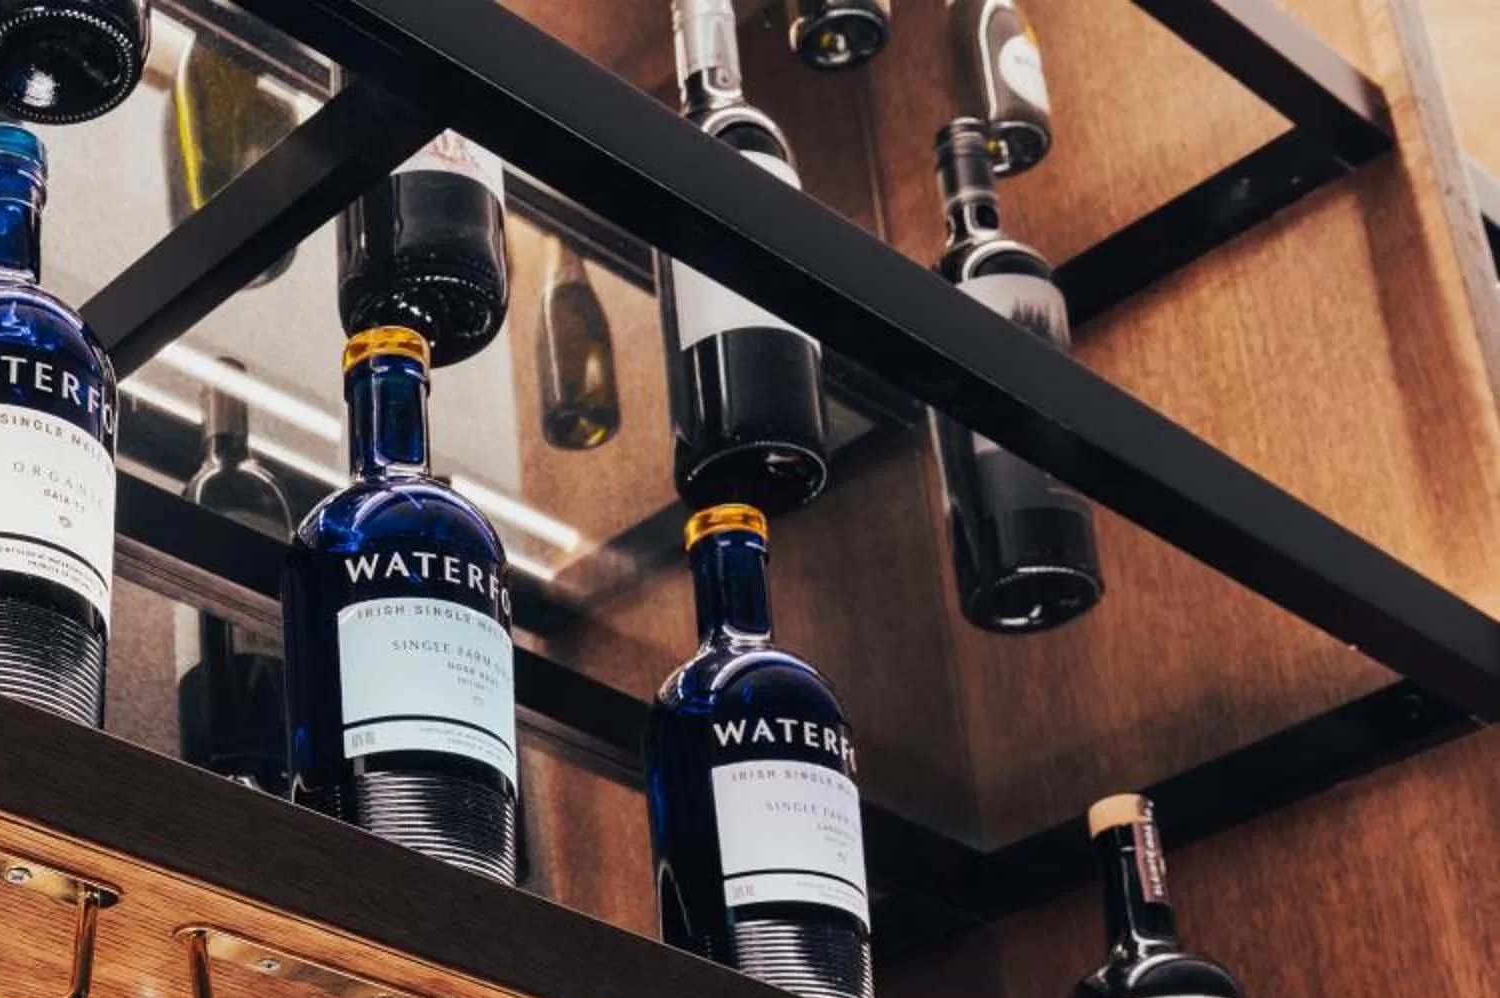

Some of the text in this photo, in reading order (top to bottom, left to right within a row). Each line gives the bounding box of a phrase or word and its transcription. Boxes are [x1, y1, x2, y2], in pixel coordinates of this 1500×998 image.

[0, 412, 64, 437] SINGLE
[357, 604, 405, 619] IRISH
[414, 605, 471, 625] SINGLE
[391, 639, 451, 653] SINGLE
